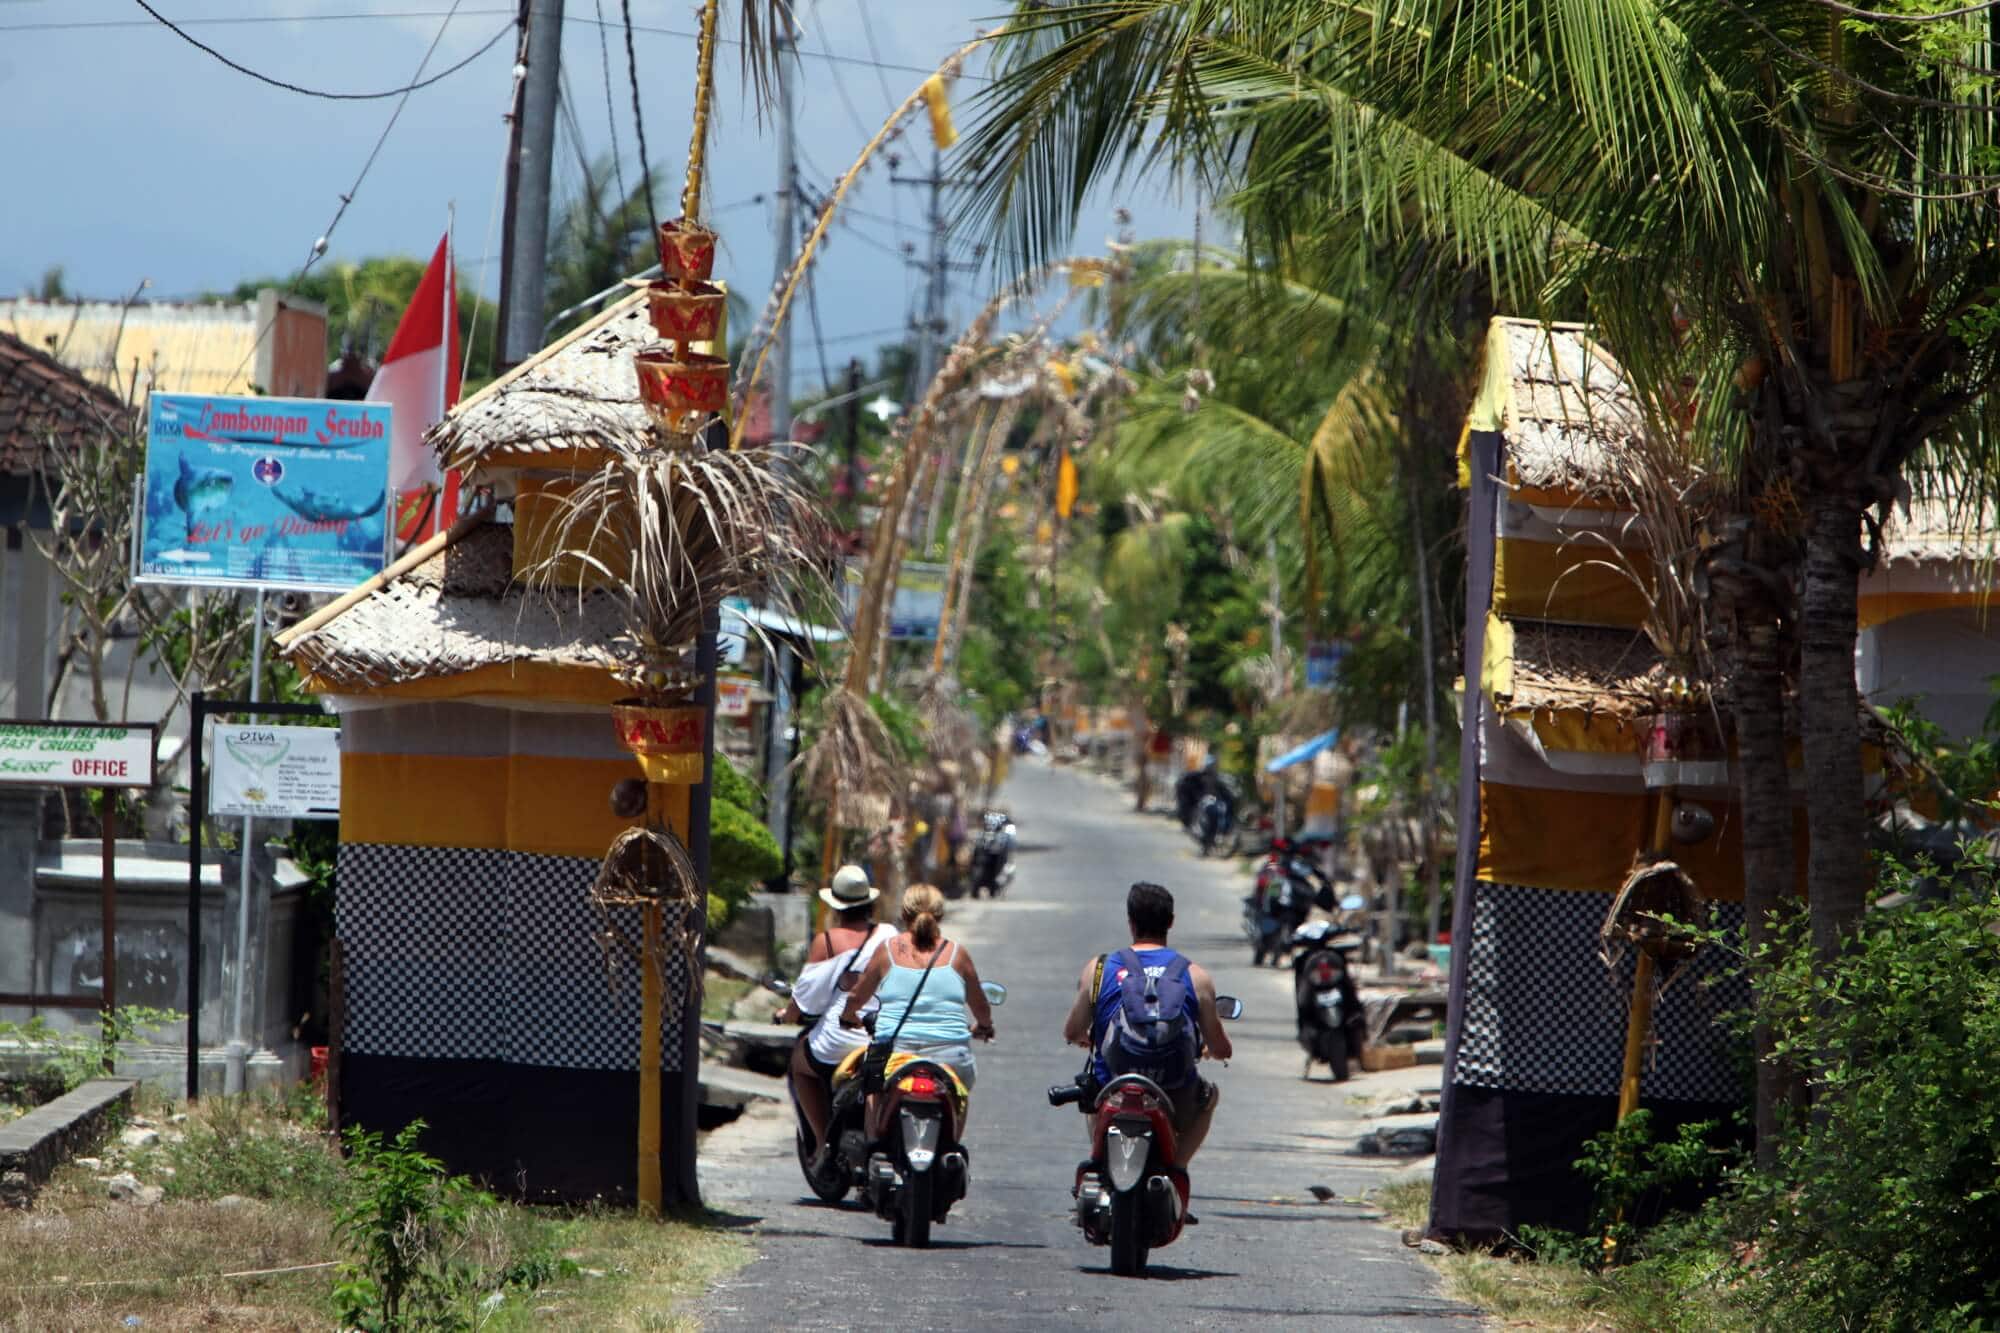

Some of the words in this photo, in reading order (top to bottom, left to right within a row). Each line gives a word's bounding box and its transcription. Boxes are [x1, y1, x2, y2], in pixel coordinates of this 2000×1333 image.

[183, 402, 308, 444] Lembongan
[315, 408, 384, 444] Scuba
[240, 525, 266, 544] go
[74, 727, 128, 741] ISLAND
[240, 731, 275, 742] DIVA
[0, 737, 36, 750] FAST
[39, 740, 97, 752] CRUISES
[72, 759, 128, 777] OFFICE
